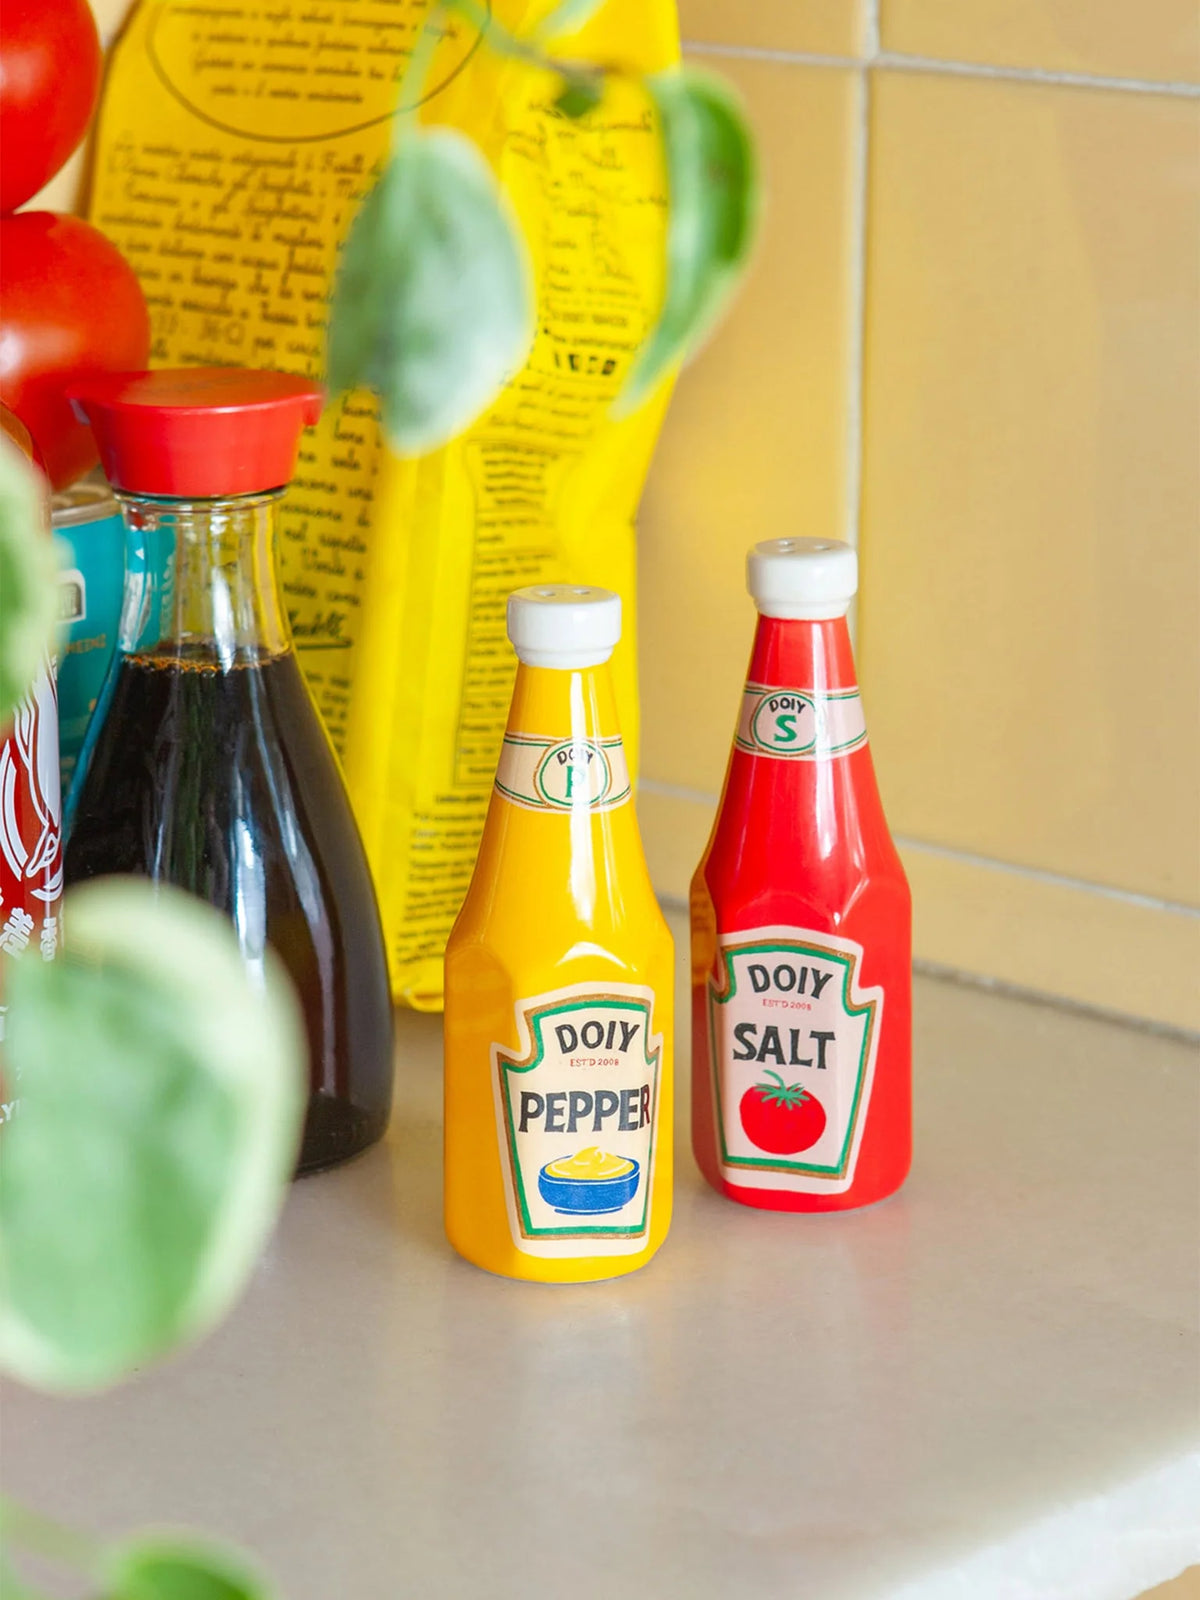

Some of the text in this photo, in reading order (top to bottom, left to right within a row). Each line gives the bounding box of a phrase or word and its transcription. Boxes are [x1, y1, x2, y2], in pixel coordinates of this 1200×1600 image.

[769, 697, 806, 714] DOIY
[774, 714, 797, 742] S
[557, 748, 594, 765] DOY
[746, 964, 834, 1000] DOIY
[790, 1001, 812, 1011] 2008
[555, 1020, 640, 1054] DOIY
[732, 1022, 836, 1070] SALT
[598, 1057, 619, 1067] 2008
[518, 1084, 651, 1133] PEPPER
